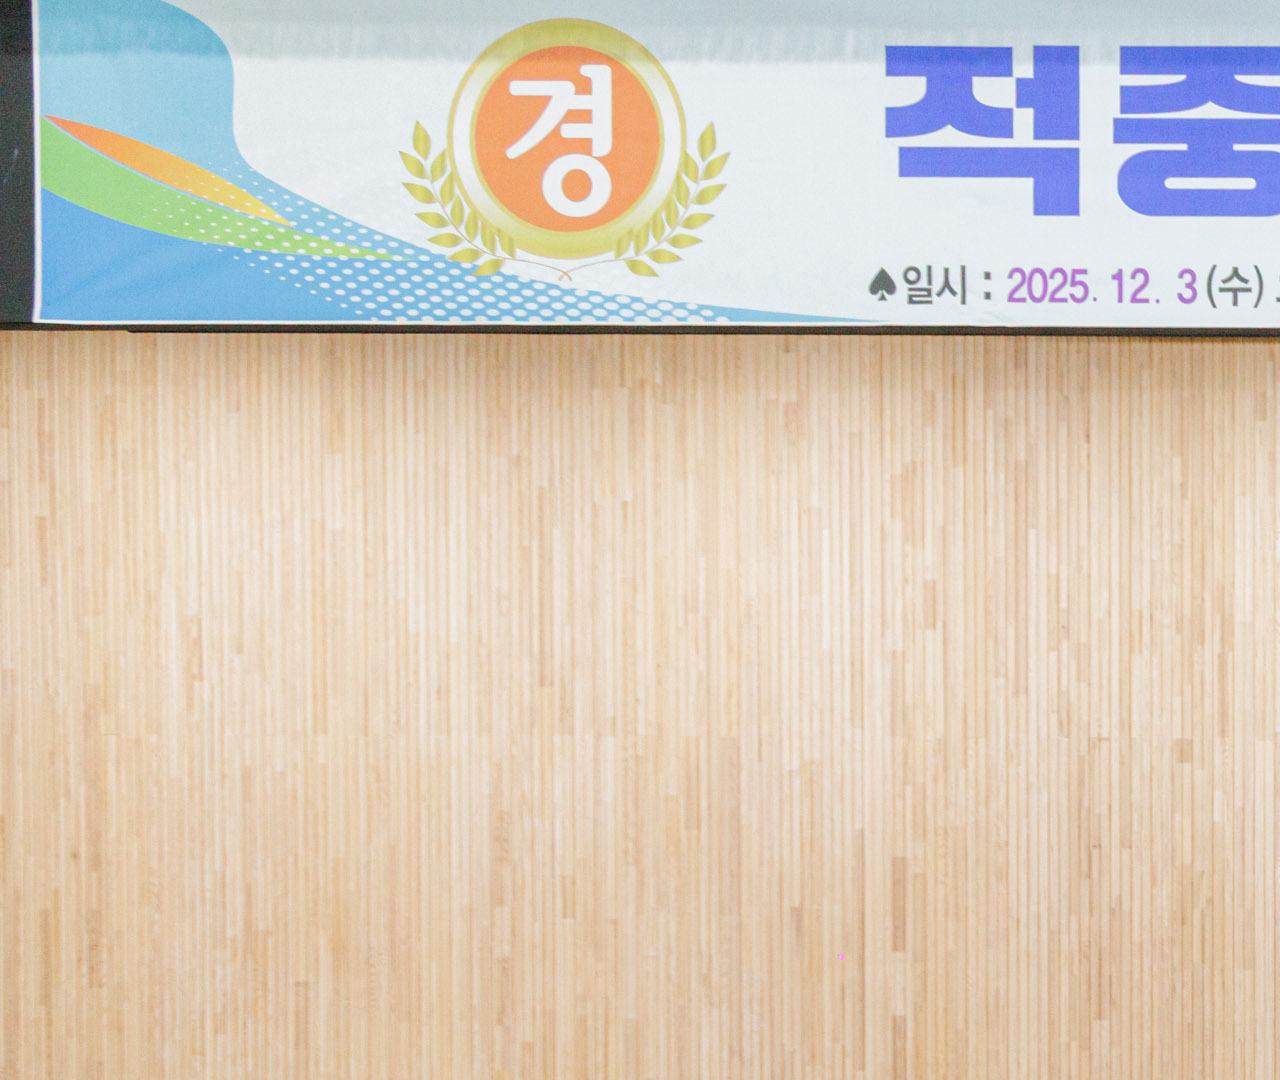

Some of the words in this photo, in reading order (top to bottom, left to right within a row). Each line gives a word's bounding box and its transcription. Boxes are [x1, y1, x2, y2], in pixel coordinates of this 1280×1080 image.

[505, 64, 612, 217] 경
[902, 264, 967, 306] 일시
[1007, 266, 1098, 304] 2025.
[1111, 267, 1161, 304] 12.
